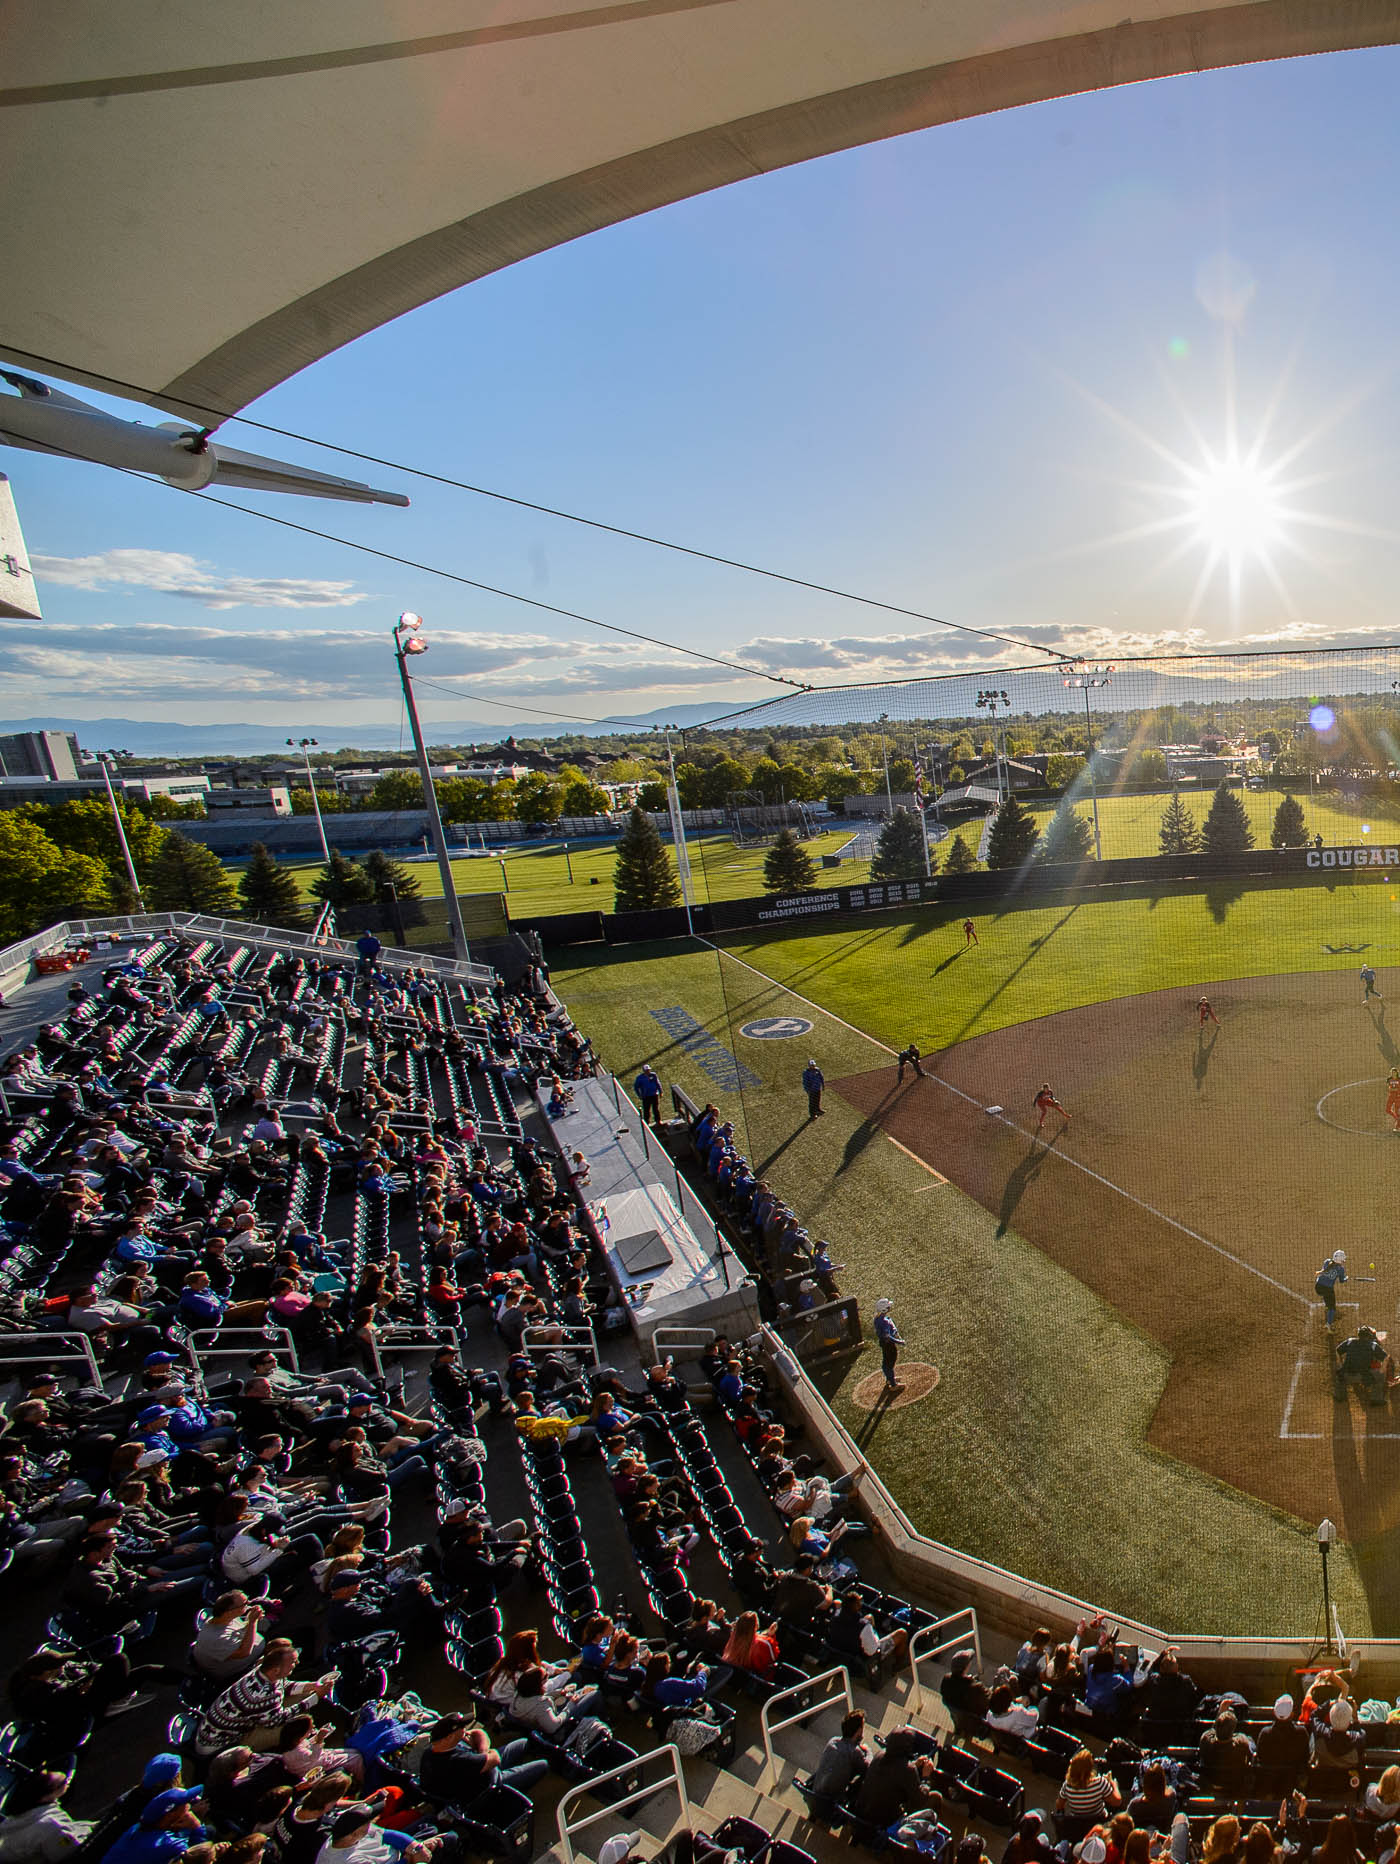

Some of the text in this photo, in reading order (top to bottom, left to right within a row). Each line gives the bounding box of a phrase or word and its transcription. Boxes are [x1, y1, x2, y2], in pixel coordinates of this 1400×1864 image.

[1306, 848, 1400, 868] COUGAR
[776, 892, 839, 908] CONFERENCE
[758, 902, 840, 920] CHAMPIONSHIPS
